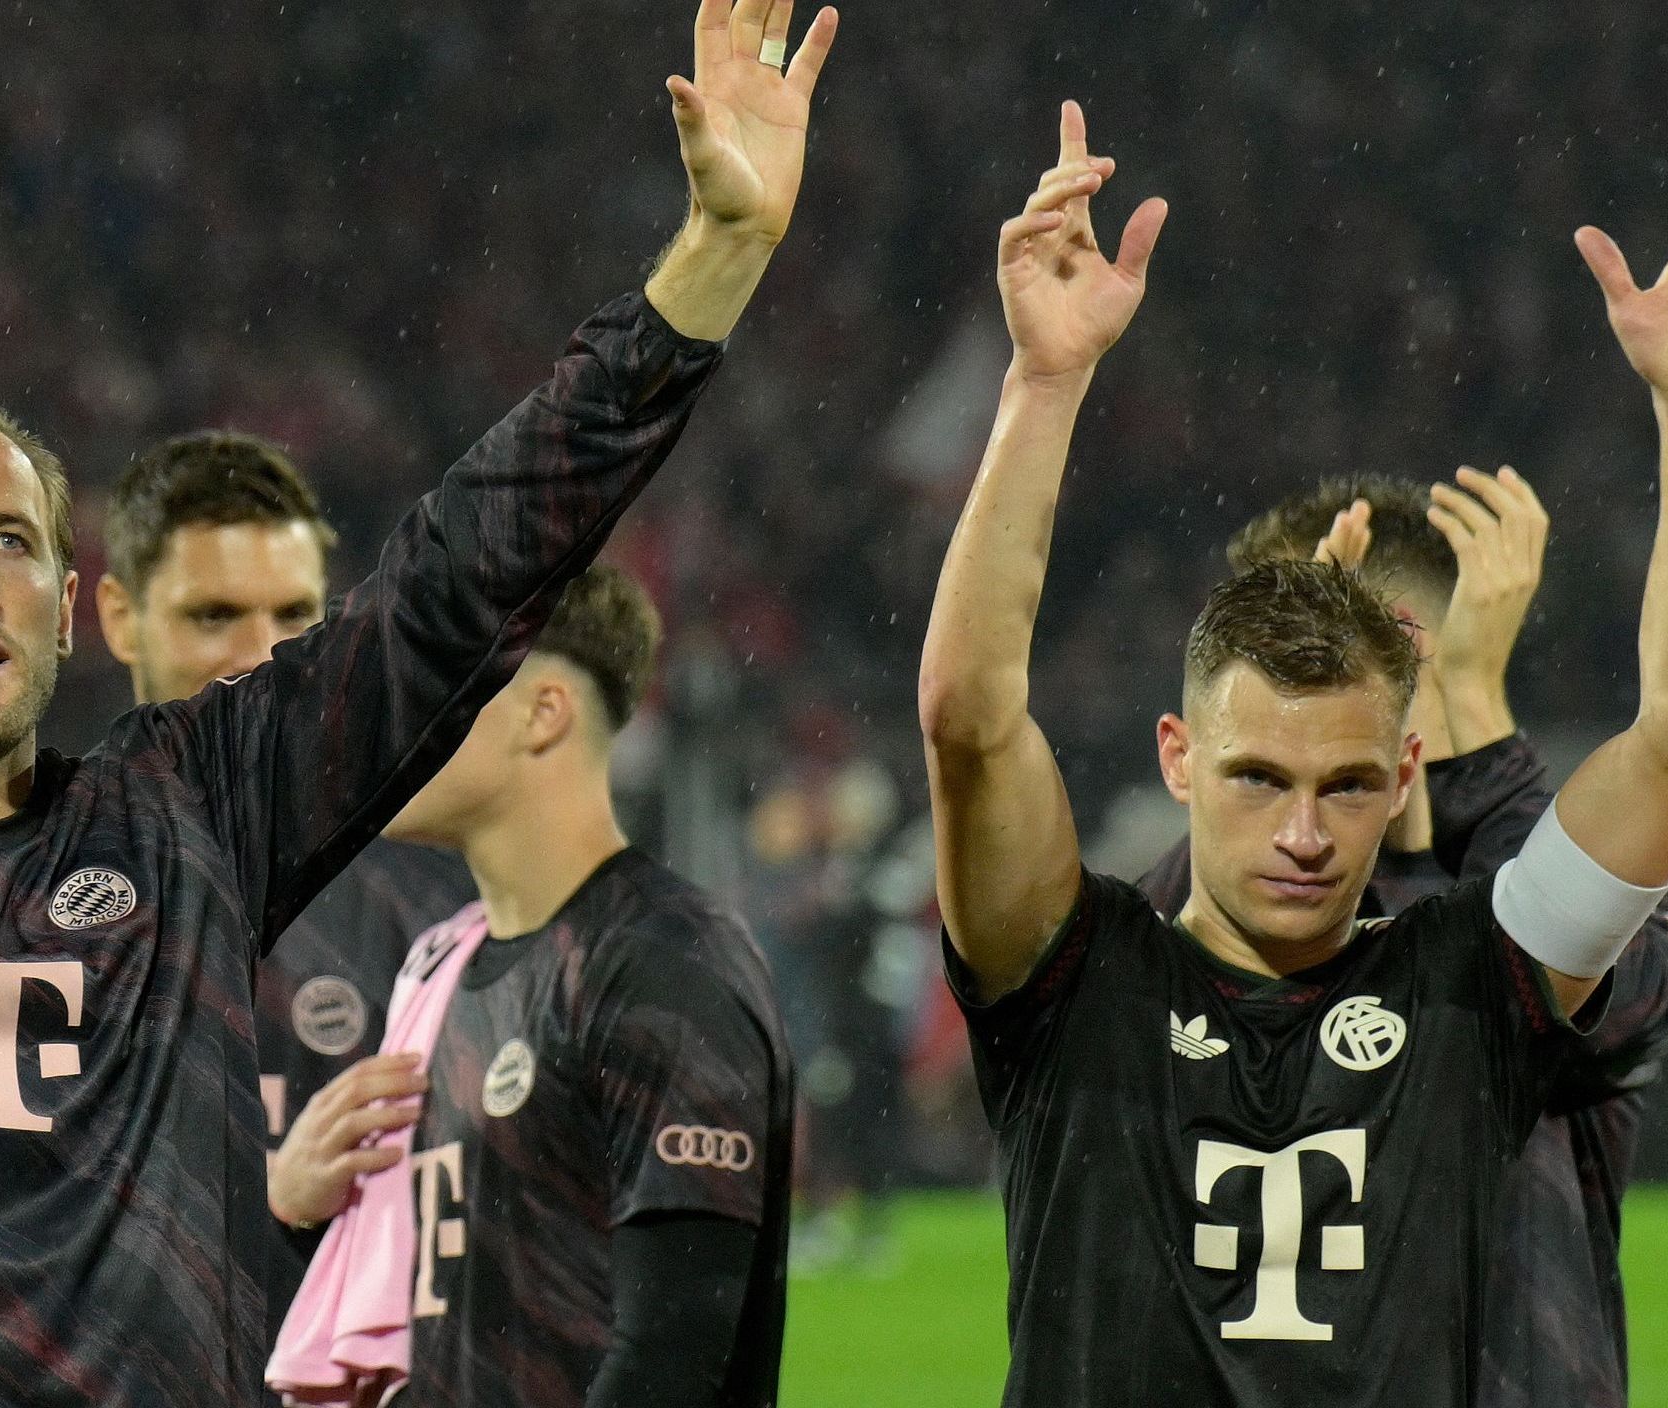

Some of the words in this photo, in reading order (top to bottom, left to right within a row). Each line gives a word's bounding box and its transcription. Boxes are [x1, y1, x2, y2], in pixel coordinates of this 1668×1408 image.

[54, 901, 66, 916] FC
[60, 872, 114, 898] BAYERN
[1193, 1128, 1366, 1341] T
